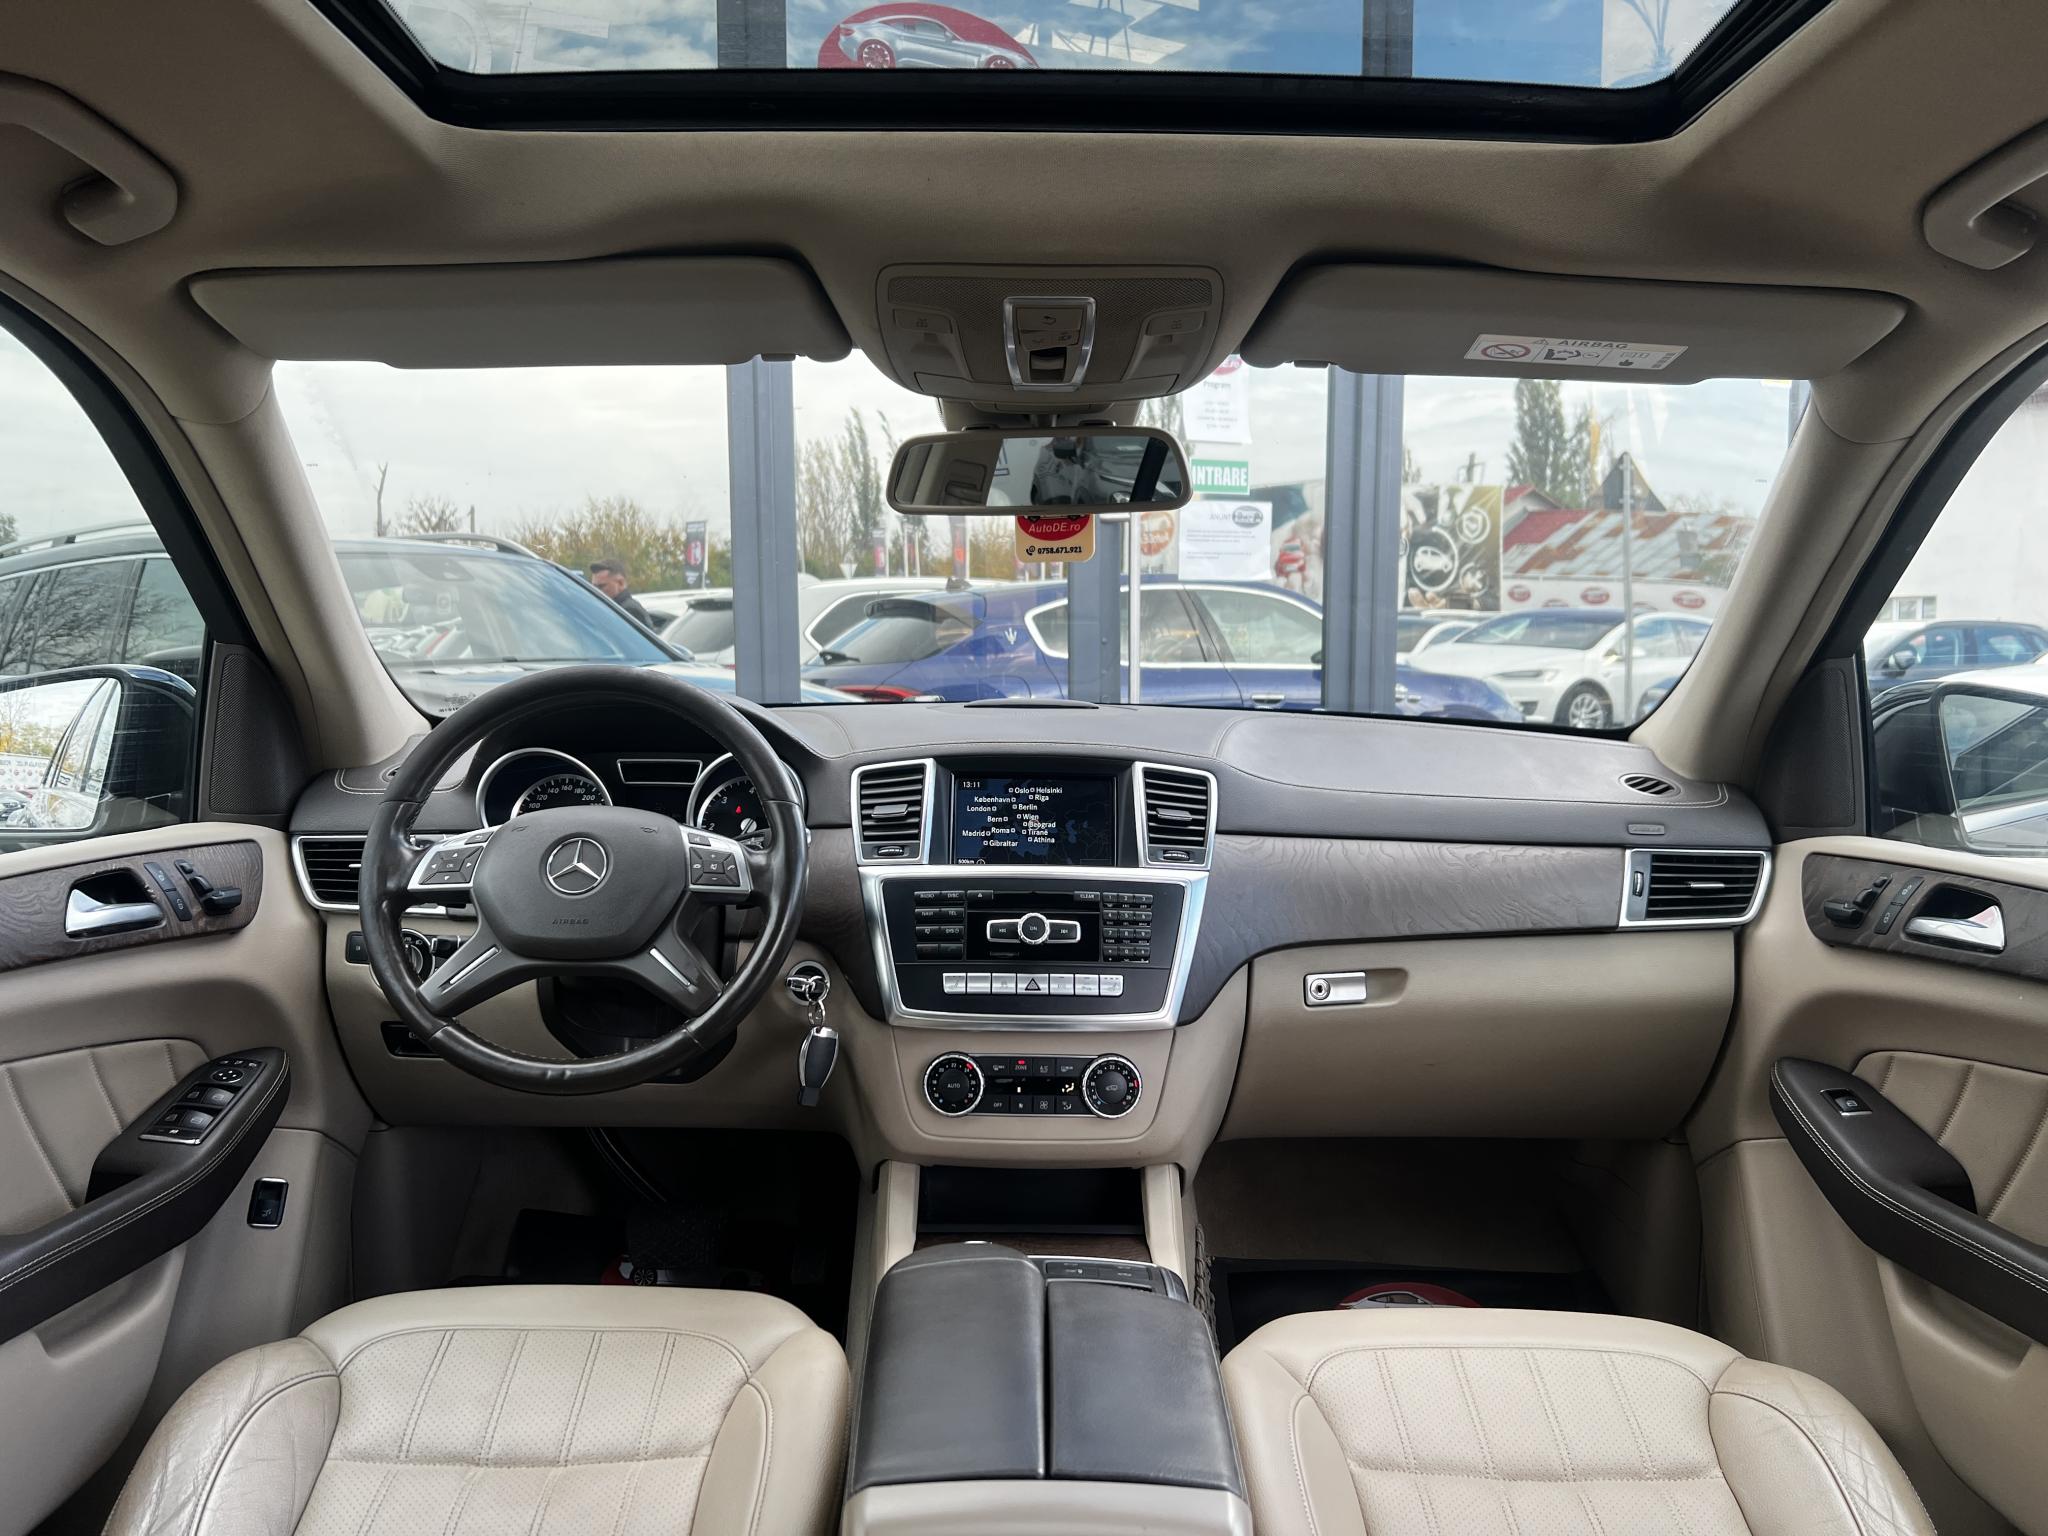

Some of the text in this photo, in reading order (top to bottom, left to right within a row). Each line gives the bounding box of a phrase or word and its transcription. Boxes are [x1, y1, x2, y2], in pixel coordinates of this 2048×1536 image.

[1558, 341, 1628, 349] AIRBAG
[1192, 466, 1248, 486] INTRARE
[1028, 523, 1081, 533] AutoDE.ro
[1037, 546, 1082, 555] 0758.671.921
[721, 796, 728, 804] 3
[1034, 794, 1050, 802] Riga
[1018, 803, 1038, 811] Berlin
[987, 815, 1003, 823] Bern
[1022, 813, 1040, 821] Wien
[708, 822, 715, 831] 2
[962, 829, 986, 837] Madrid
[989, 839, 1019, 848] Gibraltar
[1033, 836, 1056, 844] Athina
